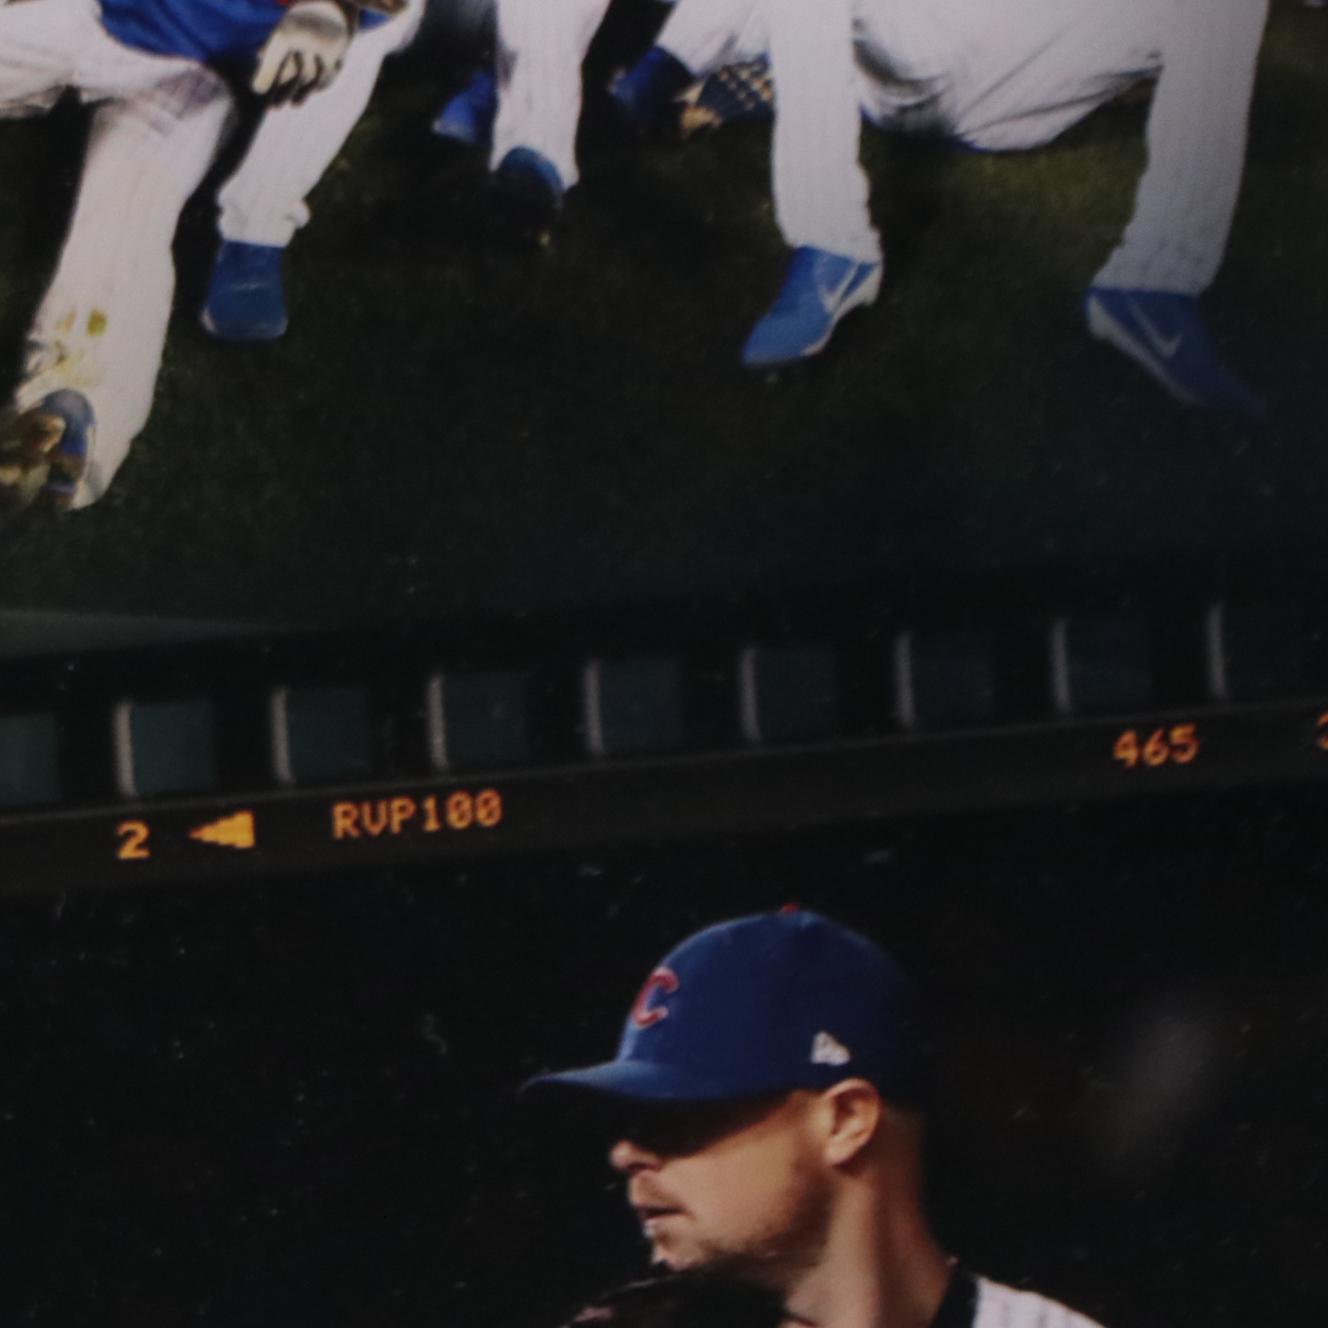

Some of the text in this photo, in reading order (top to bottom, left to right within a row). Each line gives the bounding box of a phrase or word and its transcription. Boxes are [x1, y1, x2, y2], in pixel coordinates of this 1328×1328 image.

[116, 819, 152, 860] 2
[331, 788, 504, 839] RVP100
[1112, 723, 1200, 768] 465
[630, 966, 680, 1030] C
